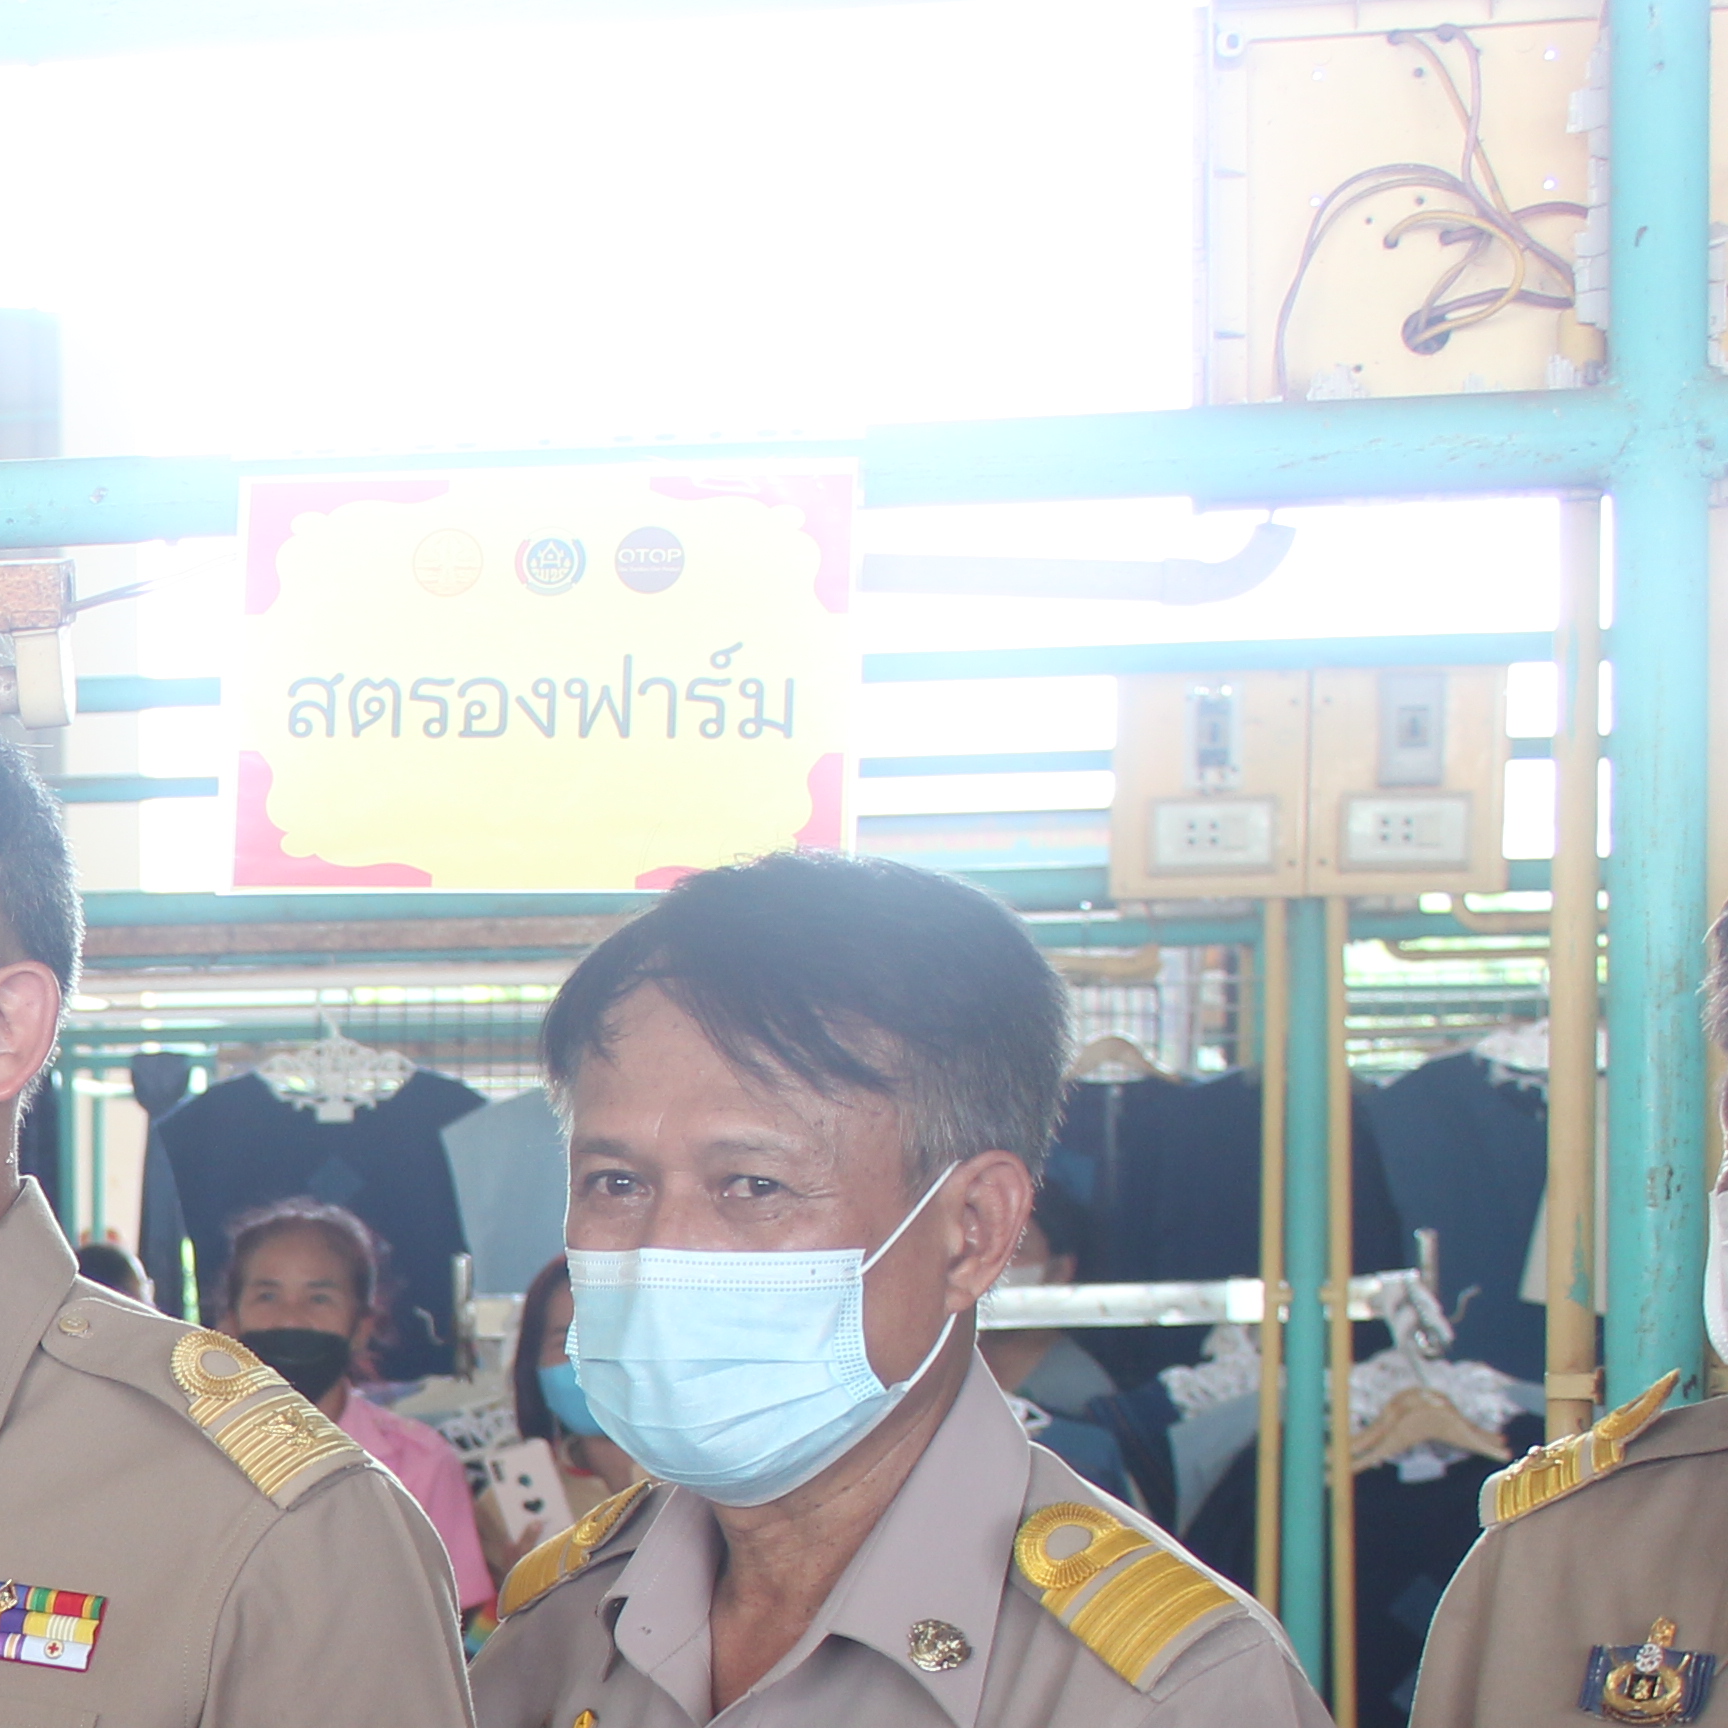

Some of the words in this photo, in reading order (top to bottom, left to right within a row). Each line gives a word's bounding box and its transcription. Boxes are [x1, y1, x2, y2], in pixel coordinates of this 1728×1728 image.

[618, 548, 682, 563] OTOP
[286, 642, 795, 740] สตรองฟาร์ม
